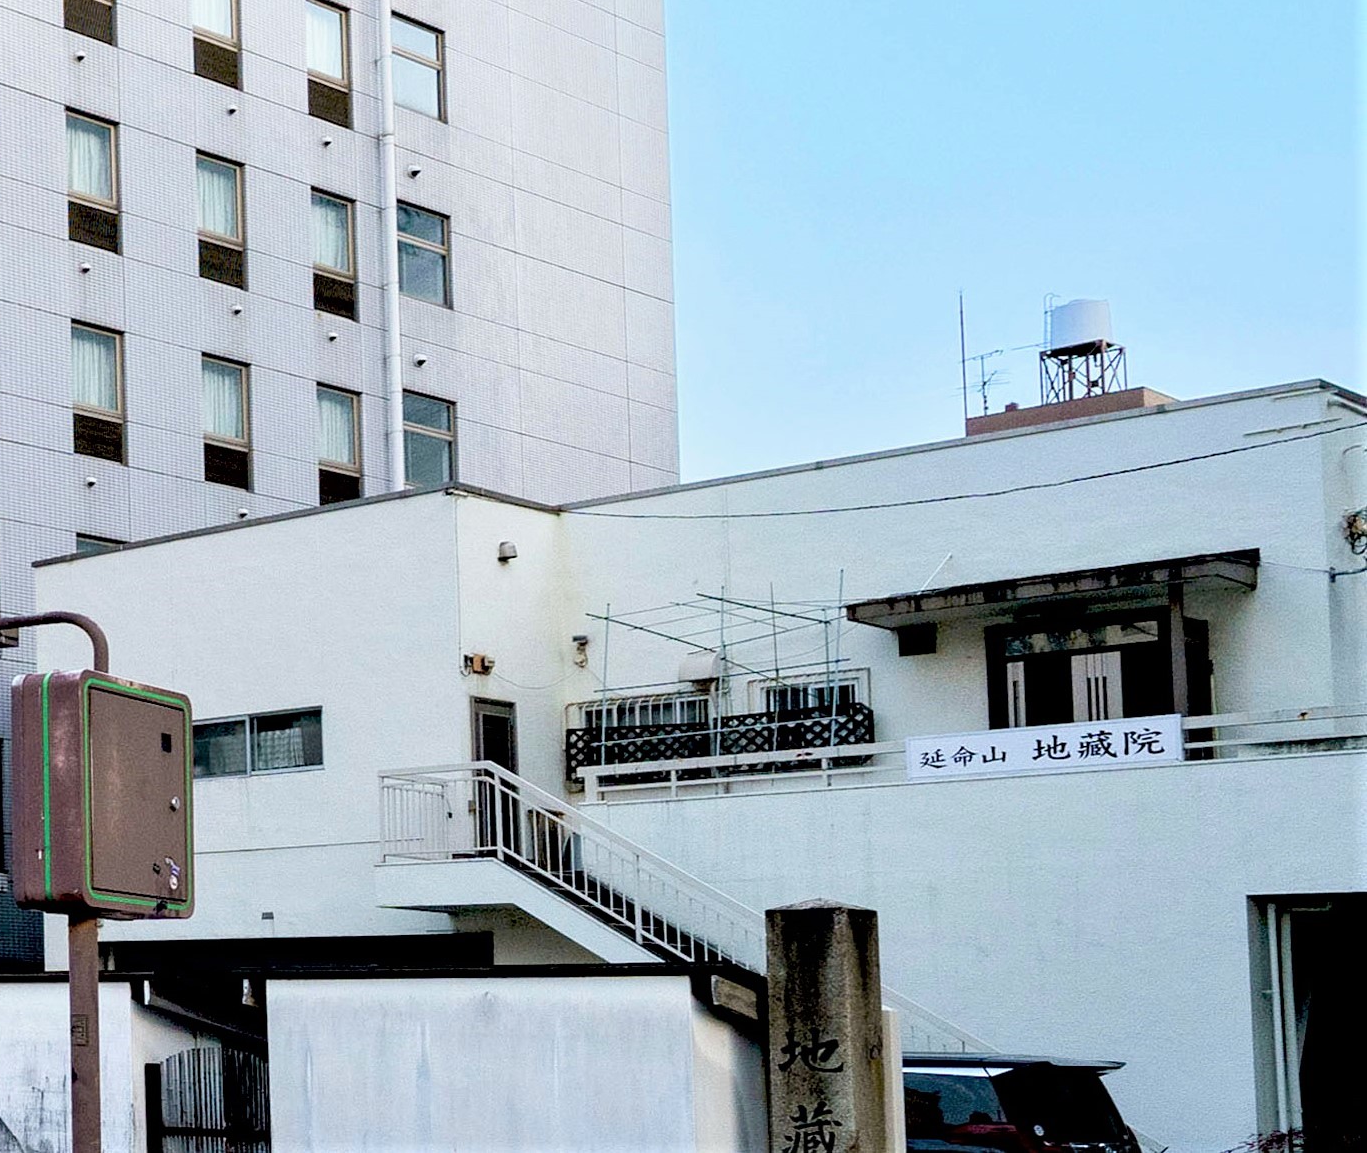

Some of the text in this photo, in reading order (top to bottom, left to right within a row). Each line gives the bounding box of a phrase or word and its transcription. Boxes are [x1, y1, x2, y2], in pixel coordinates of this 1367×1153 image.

[920, 728, 1165, 769] 延命山 地藏院
